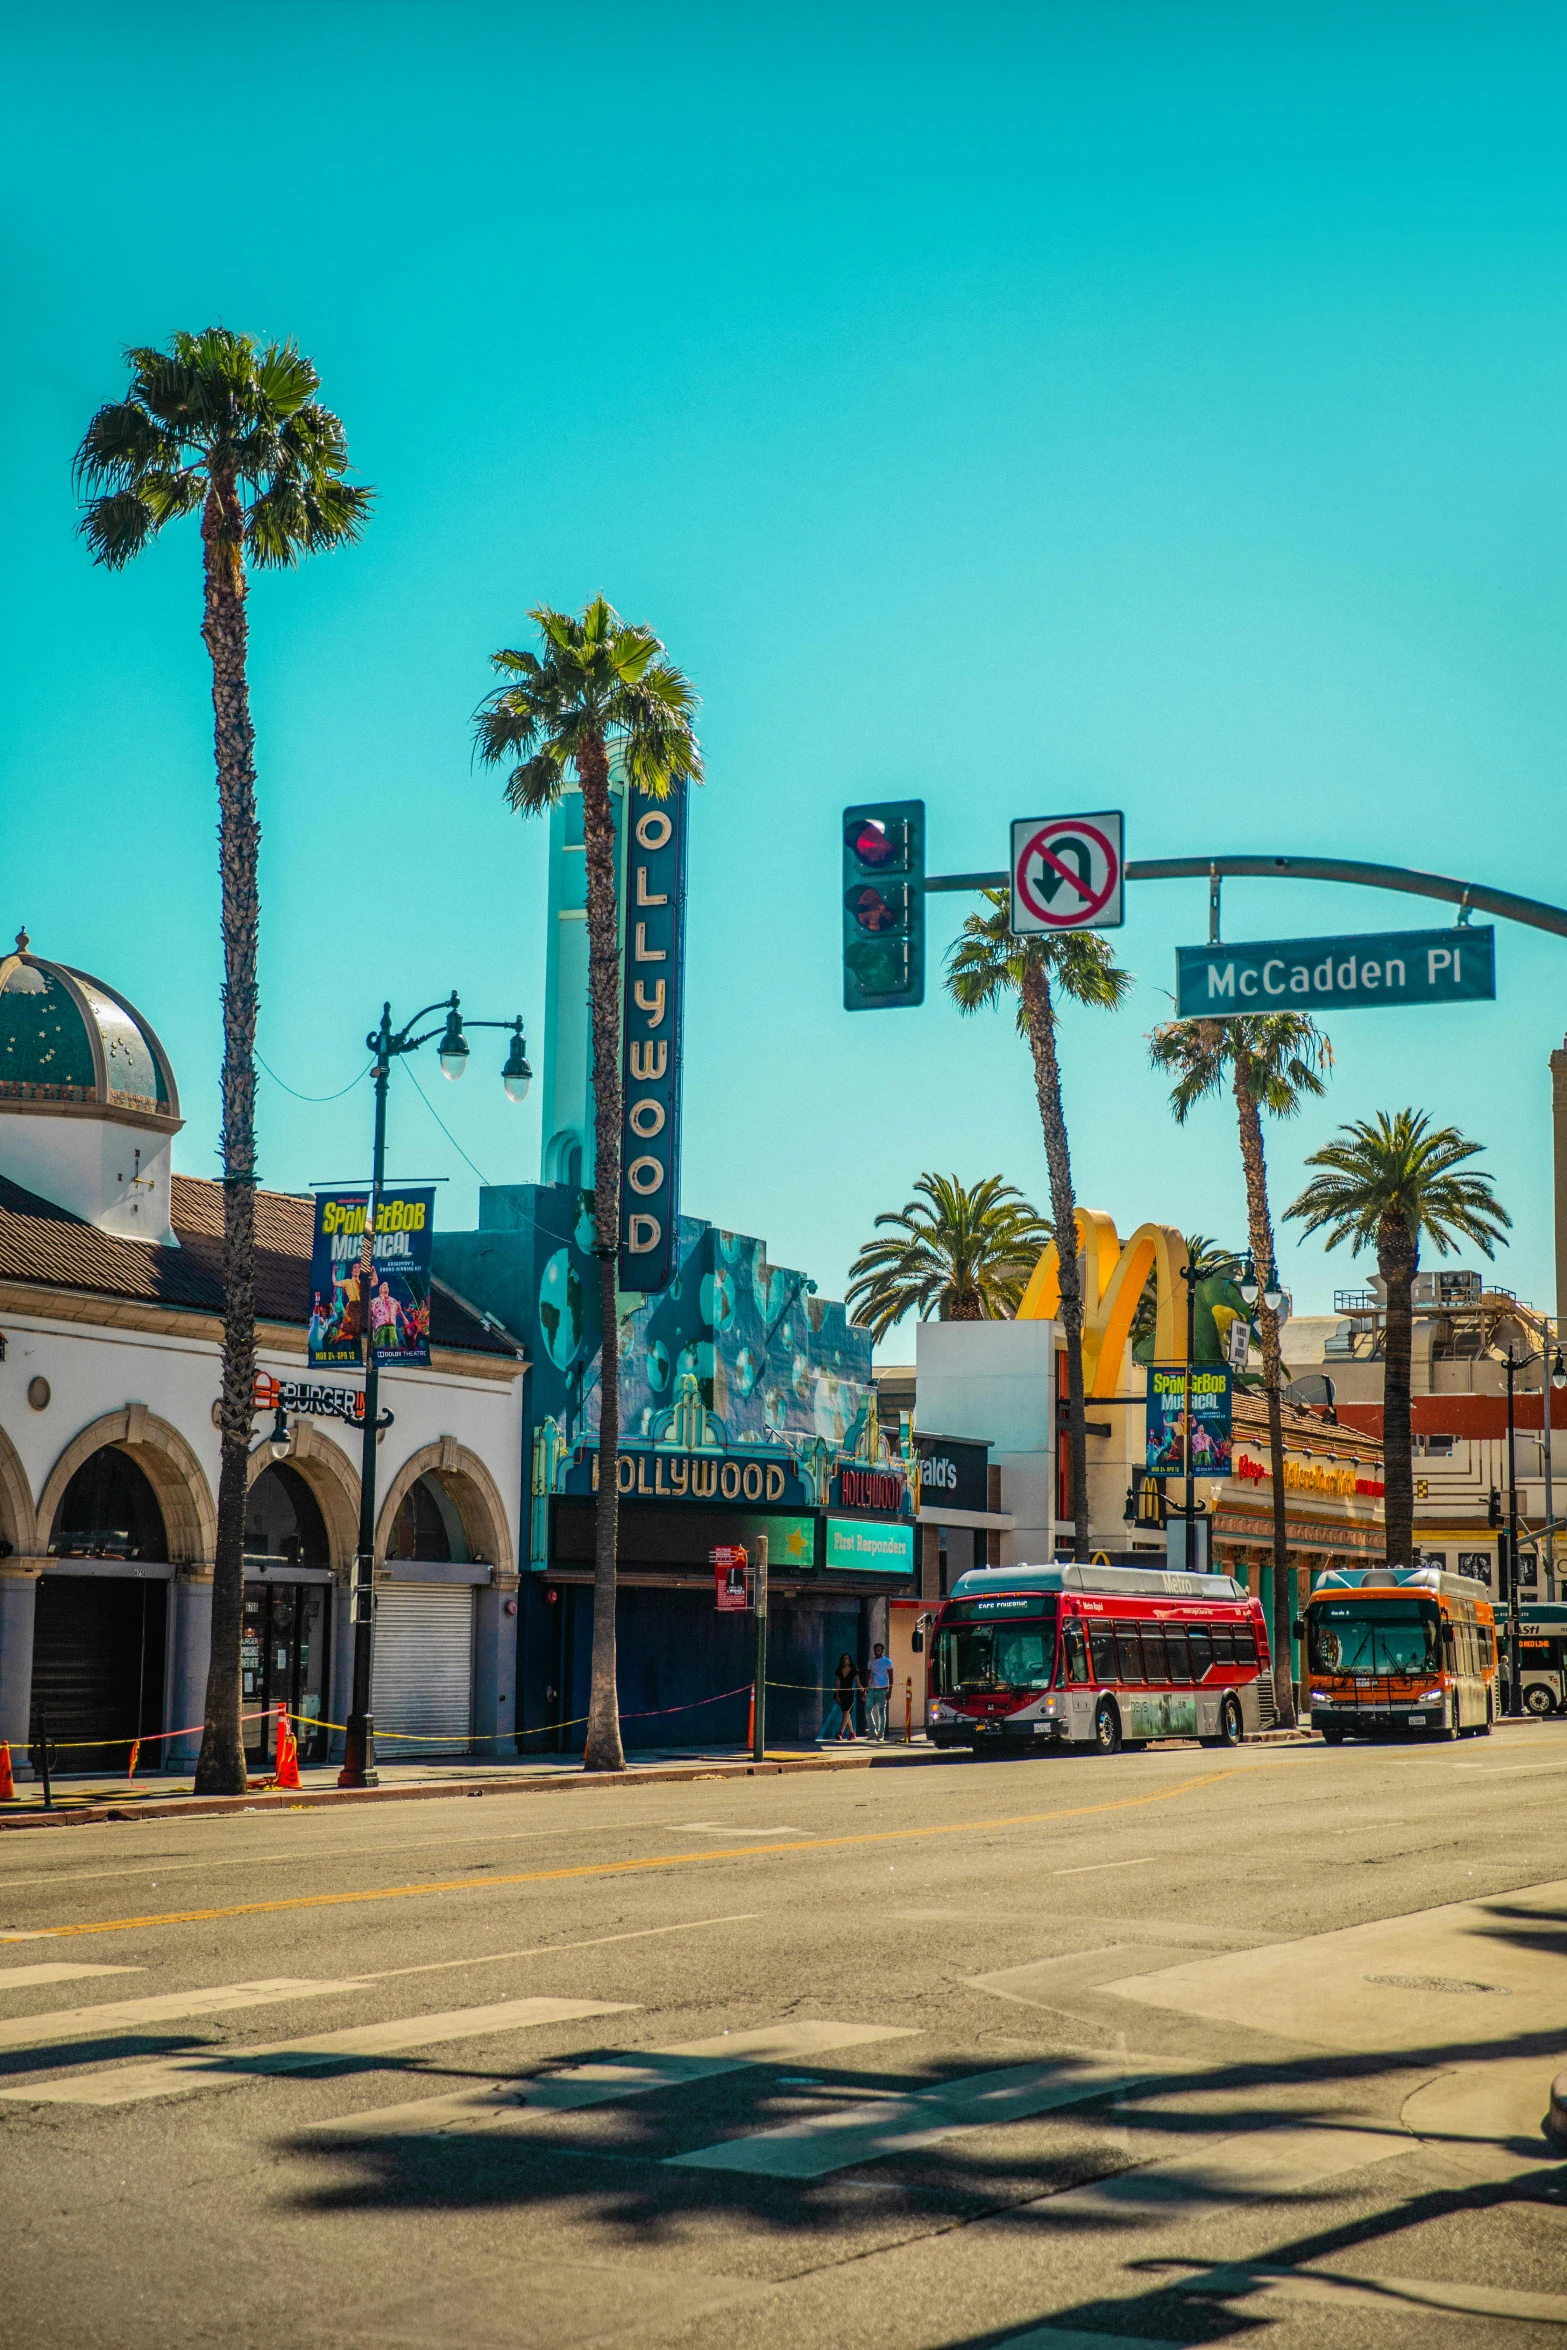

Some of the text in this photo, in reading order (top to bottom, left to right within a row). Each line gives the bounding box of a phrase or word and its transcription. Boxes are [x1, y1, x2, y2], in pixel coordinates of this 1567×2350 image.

[1207, 948, 1461, 999] McCadden Pl
[627, 775, 672, 1254] OLLYWOOD
[842, 1470, 903, 1513] HOLLYWOOD
[921, 1457, 957, 1489] ald's
[834, 1532, 906, 1556] First Responders
[1162, 1573, 1193, 1594] Metro
